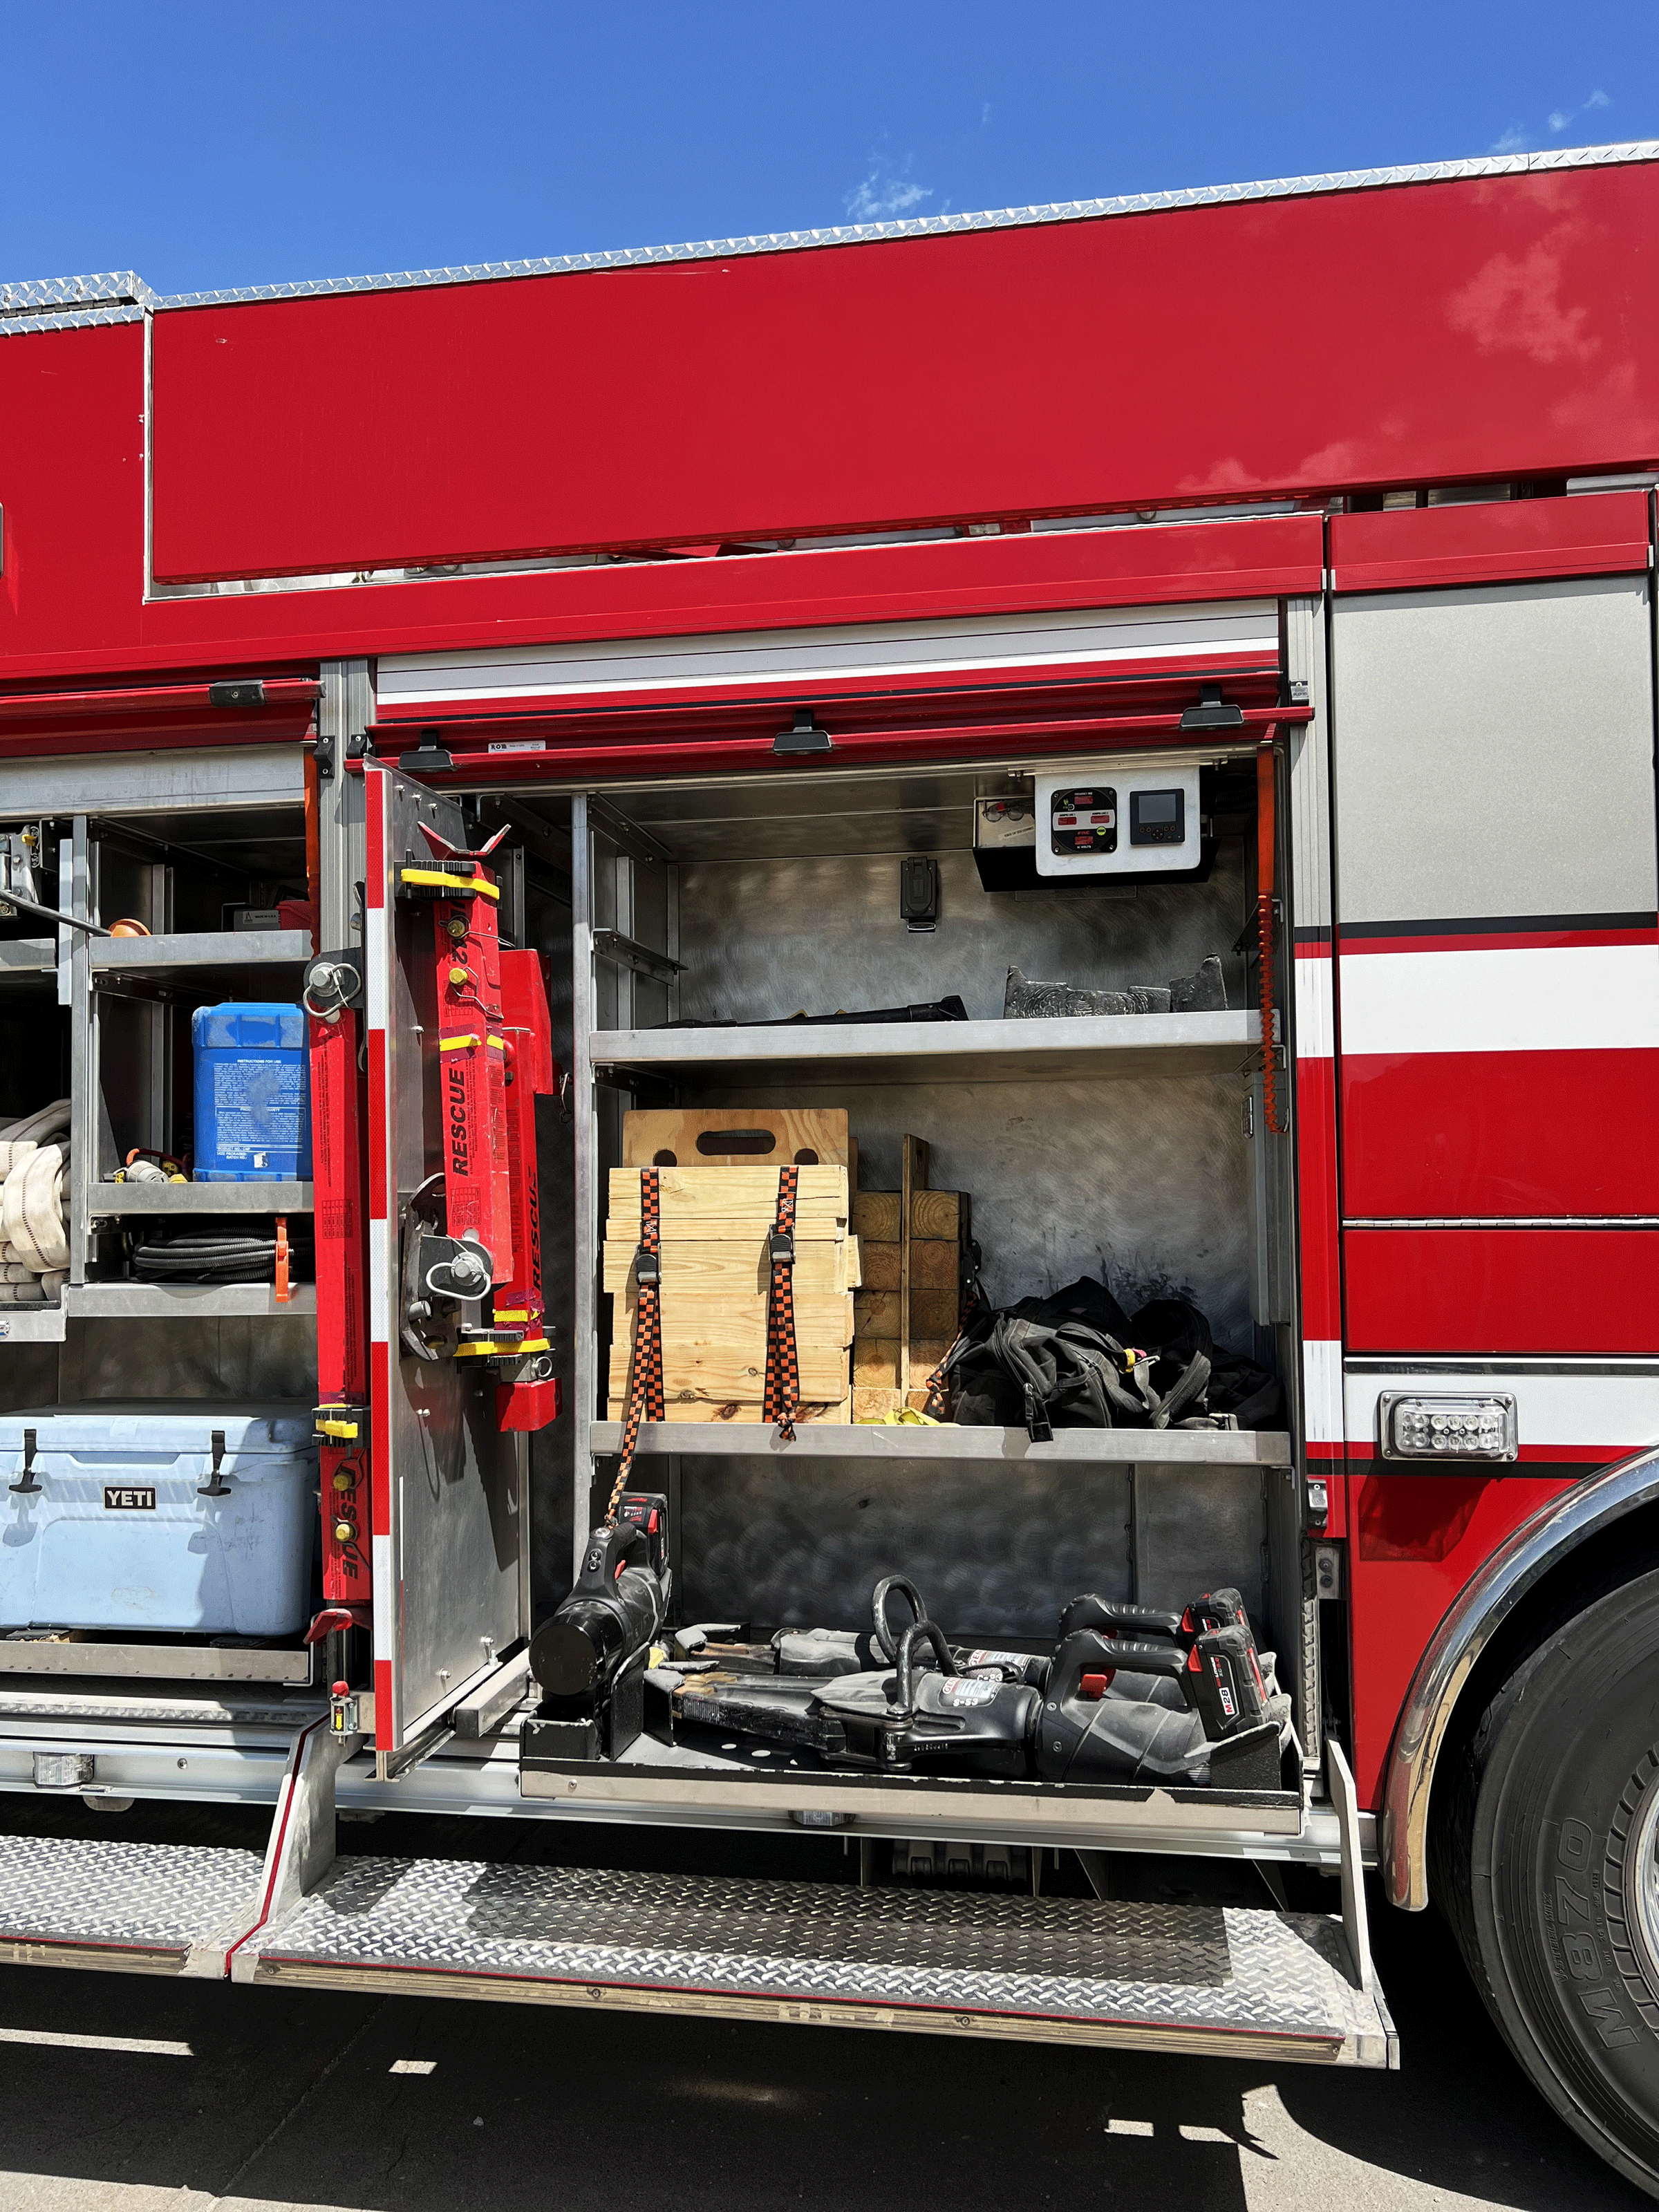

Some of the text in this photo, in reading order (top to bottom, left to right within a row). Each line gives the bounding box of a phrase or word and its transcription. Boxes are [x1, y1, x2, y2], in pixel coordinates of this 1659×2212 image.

[449, 1067, 469, 1177] RESCUE
[527, 1165, 542, 1293] RESCUE
[106, 1490, 152, 1506] YETI
[953, 1698, 979, 1707] S-53
[1221, 1689, 1233, 1714] M28
[1555, 1817, 1640, 2050] M870
